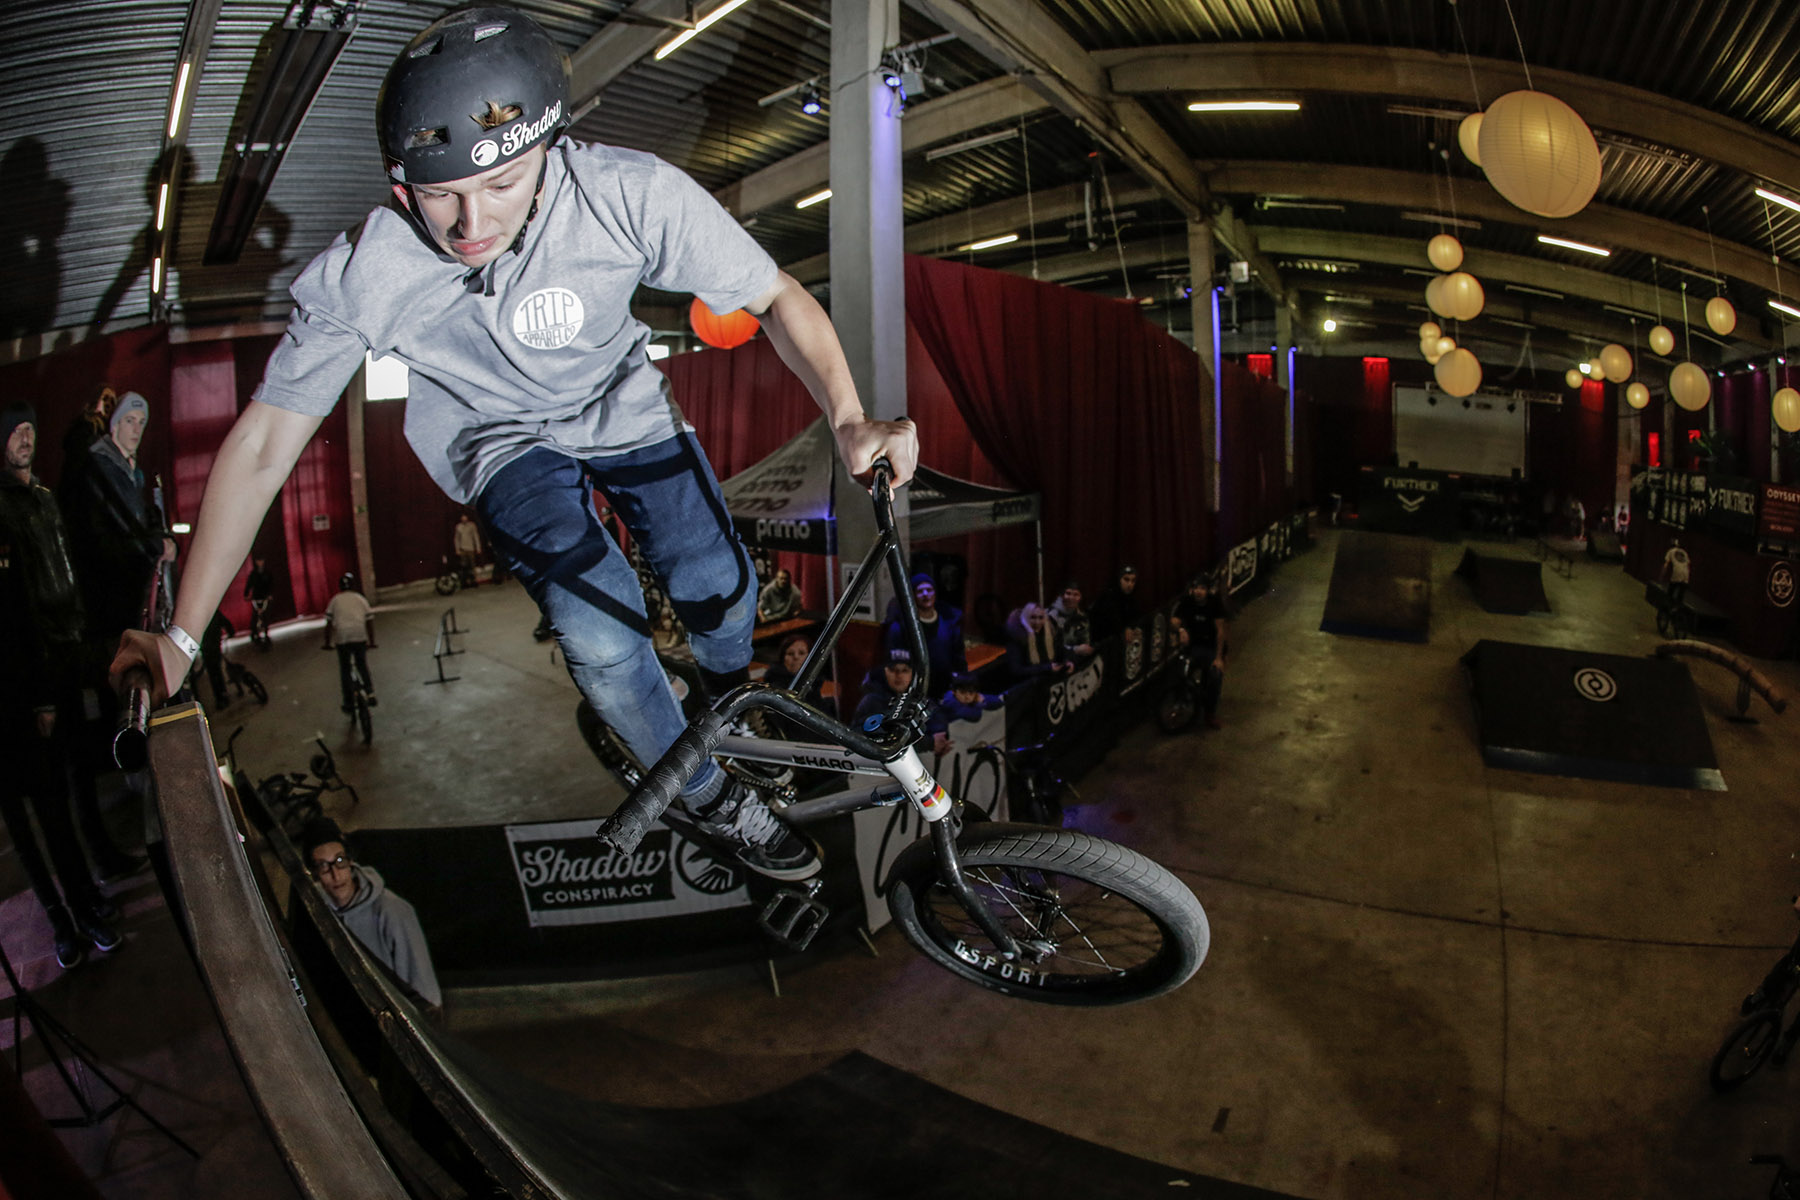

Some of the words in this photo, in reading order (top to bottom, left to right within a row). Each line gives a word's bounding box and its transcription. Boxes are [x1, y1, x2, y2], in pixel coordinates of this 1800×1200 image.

[501, 99, 562, 157] Shadow
[520, 291, 574, 332] TRIP
[523, 329, 565, 348] APPAREL
[1718, 488, 1756, 515] FURTHER
[756, 518, 811, 542] primo
[892, 692, 909, 720] HARO
[806, 755, 856, 772] HARO
[522, 846, 666, 888] Shadow
[543, 883, 654, 904] CONSPIRACY
[954, 939, 1050, 987] GSPORT
